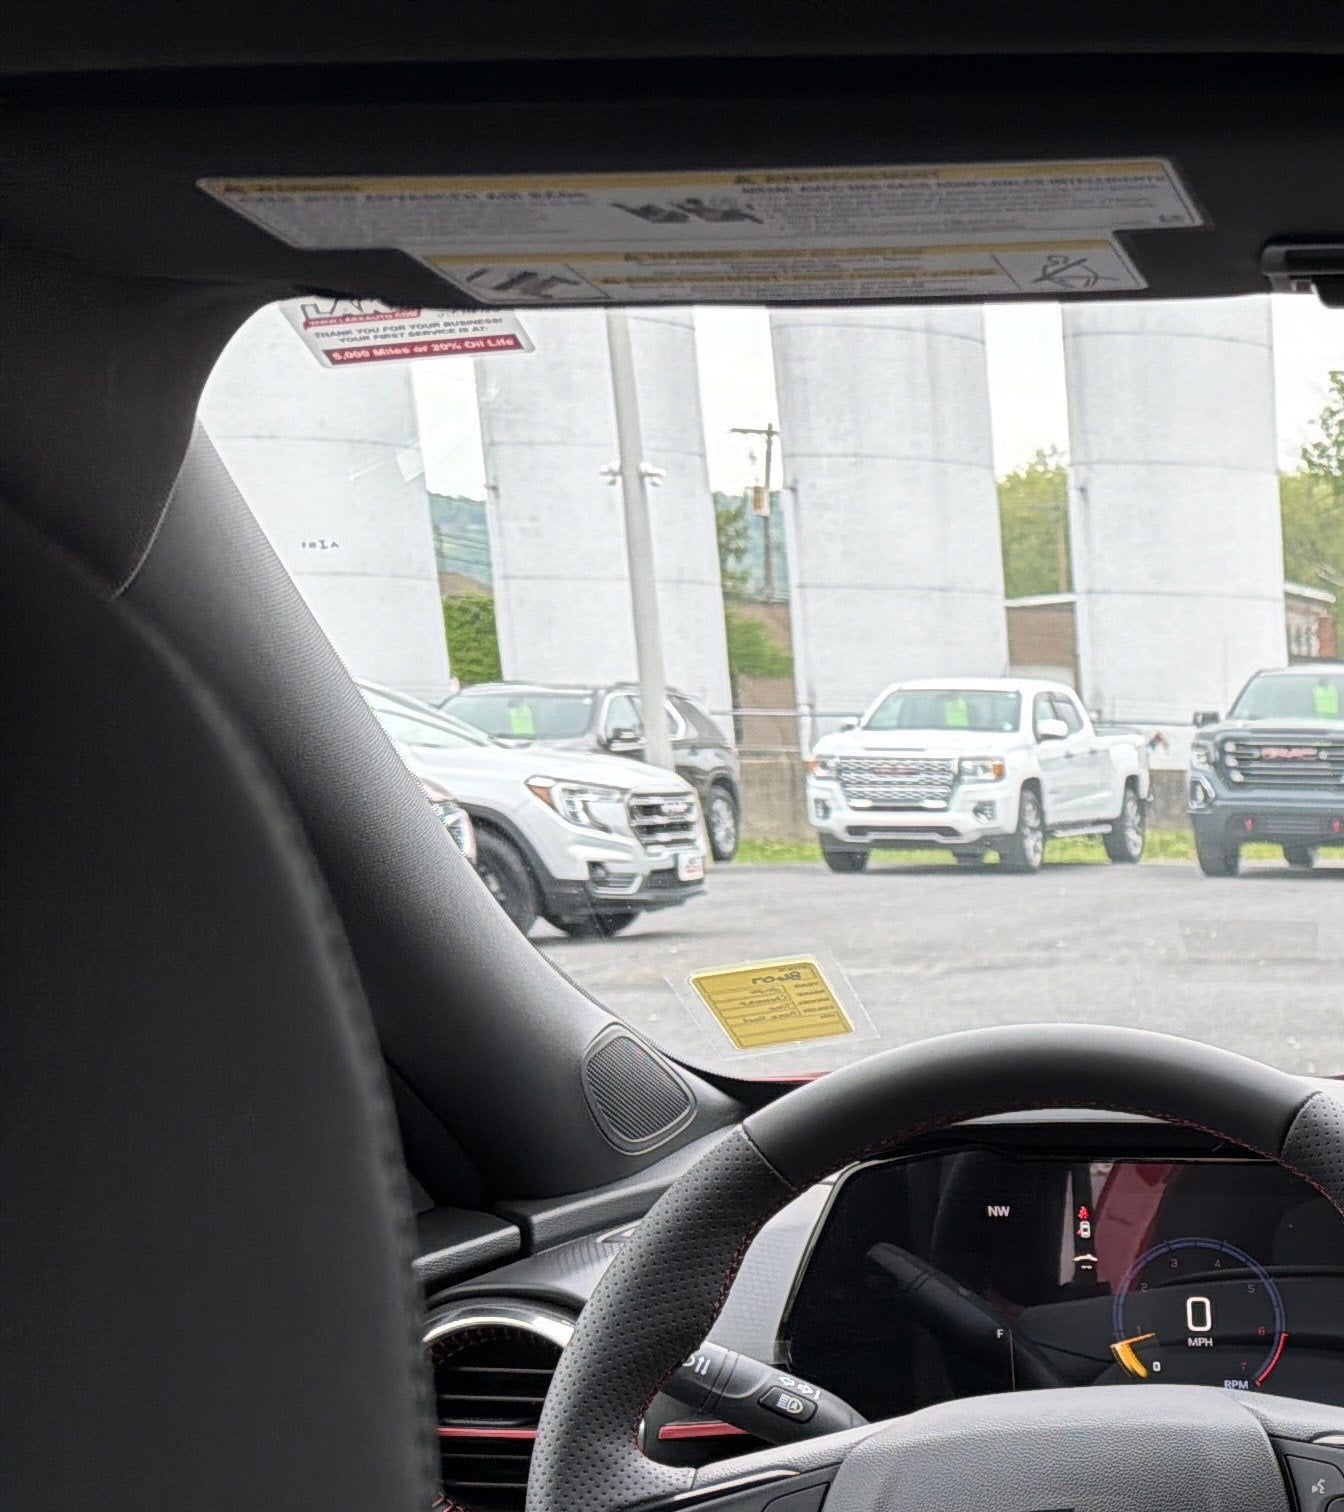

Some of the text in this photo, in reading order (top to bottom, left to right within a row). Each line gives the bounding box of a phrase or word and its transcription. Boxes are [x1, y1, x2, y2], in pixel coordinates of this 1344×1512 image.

[409, 322, 440, 330] YOUR
[408, 328, 456, 338] SERVICE
[987, 1205, 1010, 1218] NW
[1170, 1258, 1178, 1268] 3
[1213, 1258, 1221, 1268] 4
[1141, 1283, 1148, 1293] 2
[1247, 1284, 1255, 1294] 5
[1186, 1296, 1212, 1332] 0
[996, 1329, 1005, 1339] F
[1187, 1336, 1214, 1347] MPH
[1224, 1379, 1249, 1390] RPM
